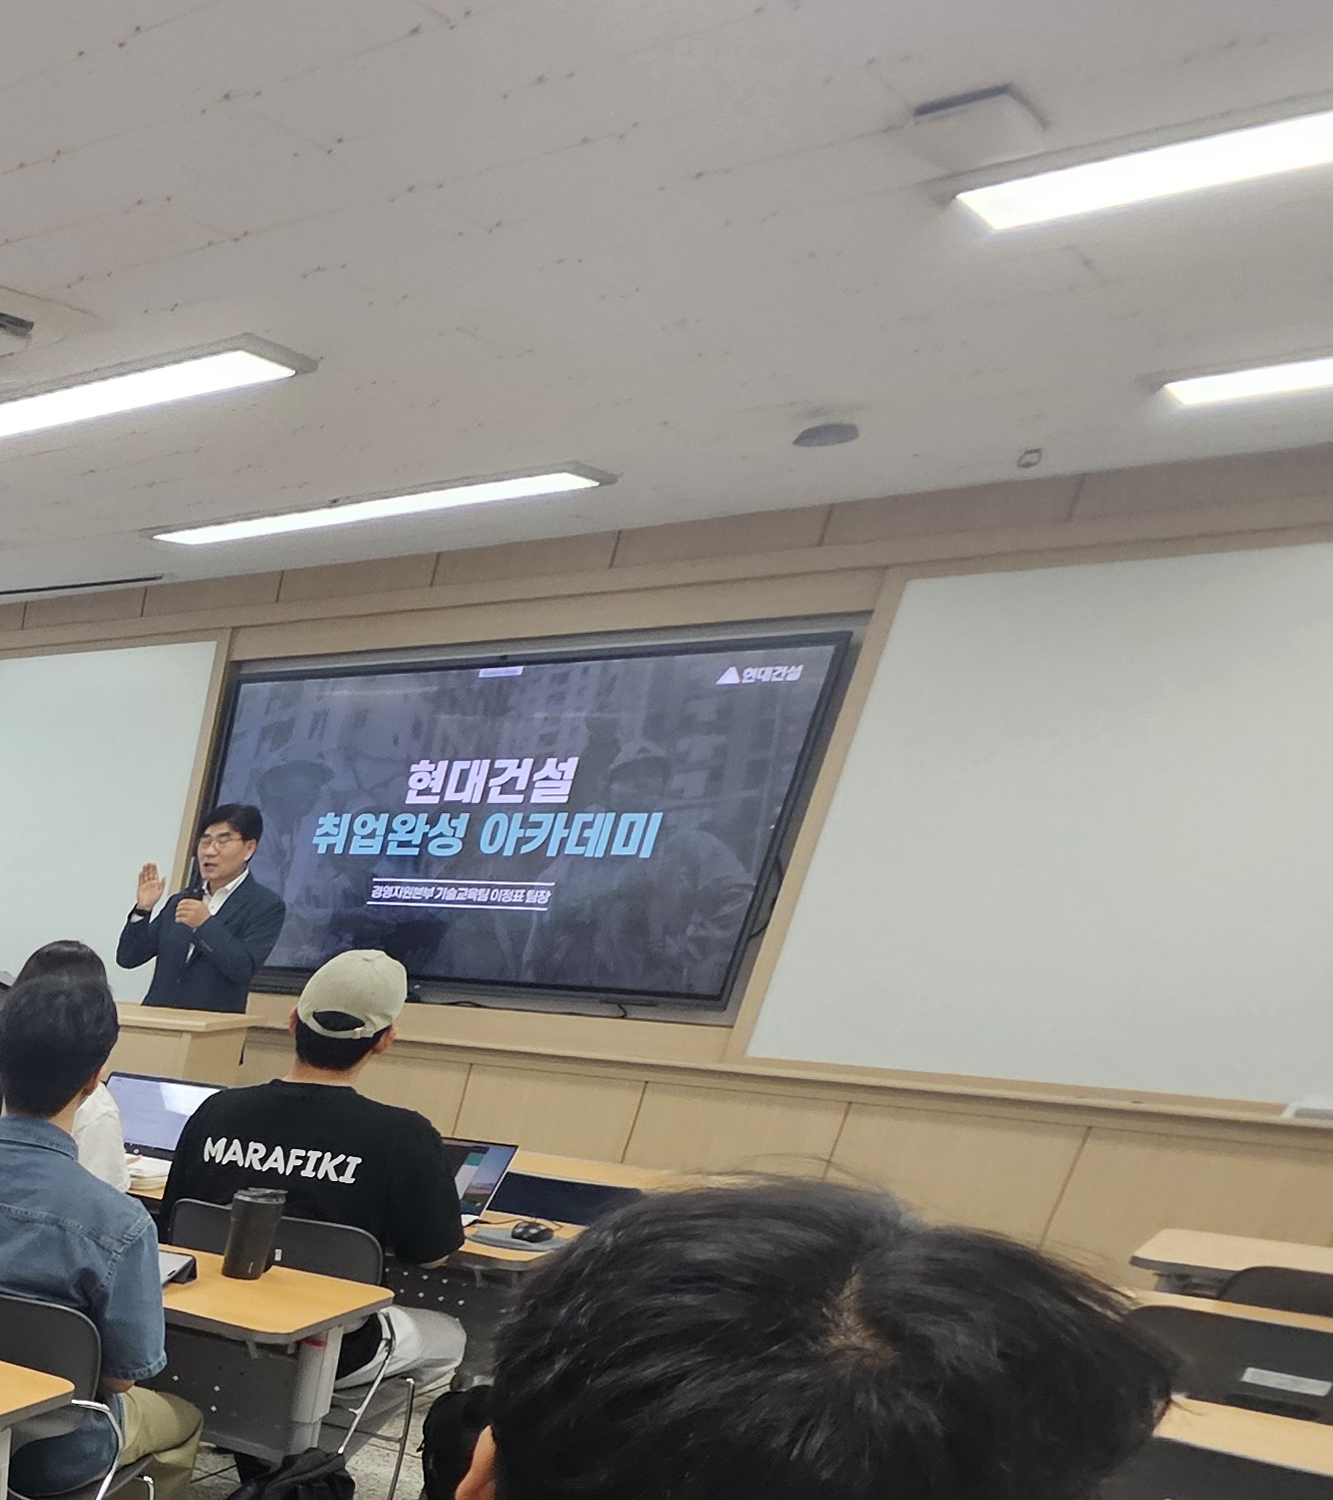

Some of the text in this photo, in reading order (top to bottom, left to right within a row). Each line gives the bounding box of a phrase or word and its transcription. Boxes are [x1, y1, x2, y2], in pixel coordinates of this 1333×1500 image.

[741, 664, 804, 683] 현대건설
[405, 757, 580, 804] 현대건설
[312, 812, 664, 858] 취업완성 아카데미
[203, 1136, 363, 1184] MARAFIKI
